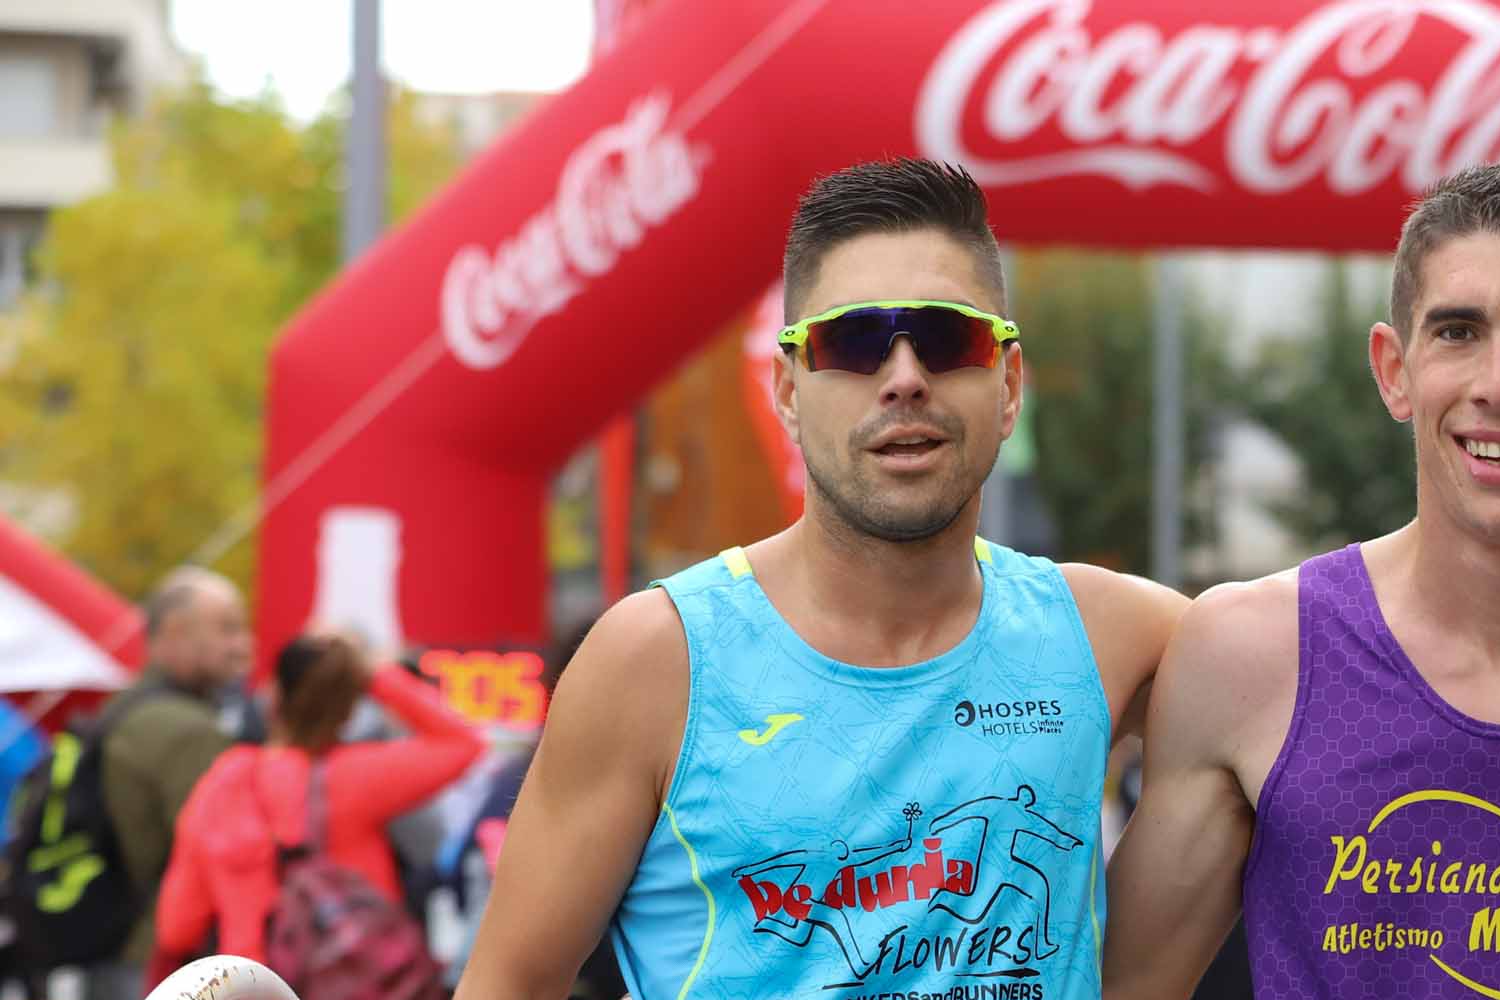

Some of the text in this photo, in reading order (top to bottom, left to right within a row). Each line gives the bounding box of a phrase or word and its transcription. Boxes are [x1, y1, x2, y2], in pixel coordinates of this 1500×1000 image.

[978, 700, 1061, 719] HOSPES
[982, 721, 1038, 736] HOTELS
[875, 925, 1034, 975] FLOWERS
[1322, 922, 1444, 954] Atletismo
